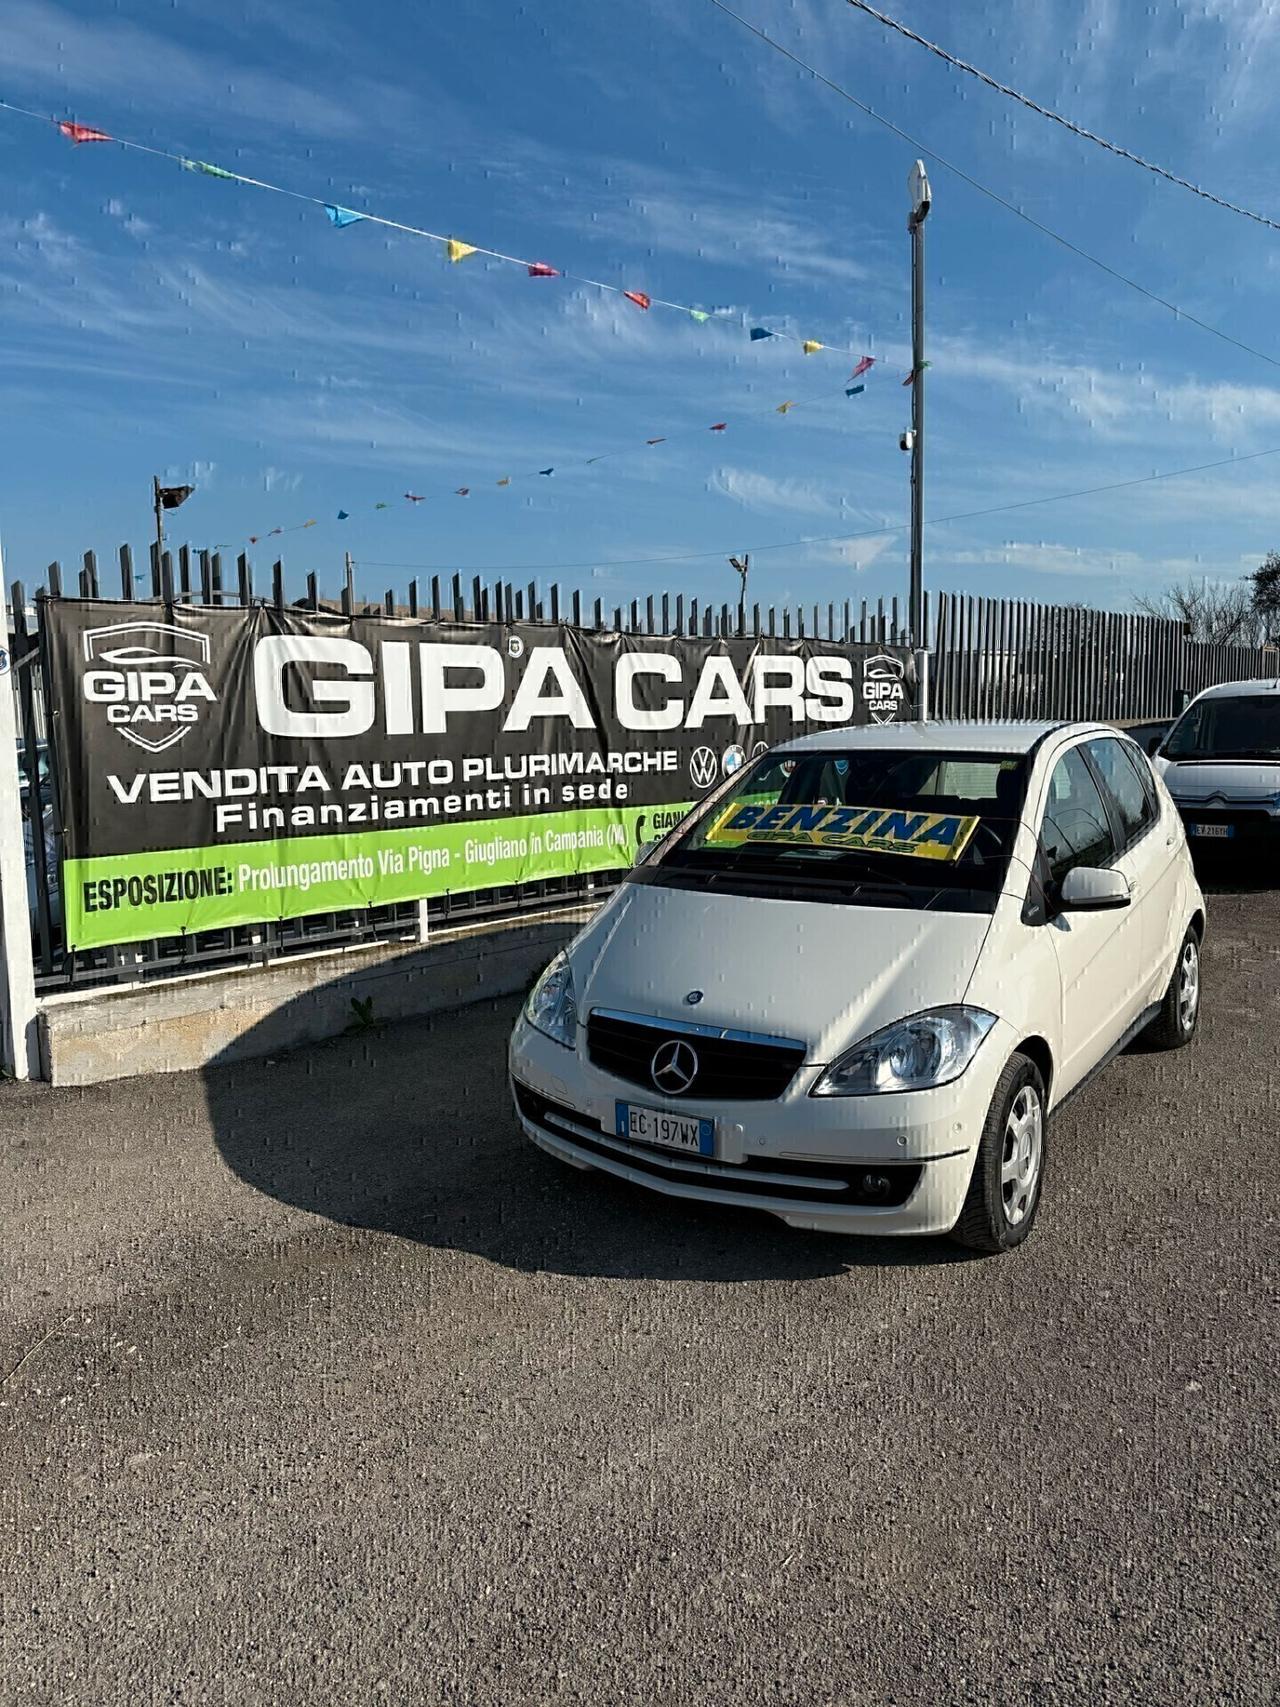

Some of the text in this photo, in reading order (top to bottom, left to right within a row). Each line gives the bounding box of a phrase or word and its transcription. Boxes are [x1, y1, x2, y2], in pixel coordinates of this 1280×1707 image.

[83, 671, 217, 702] GIPA
[253, 635, 854, 738] GIPA CARS
[863, 682, 904, 699] GIPA
[107, 704, 199, 723] CARS
[868, 700, 898, 711] CARS
[107, 751, 678, 804] VENDITA AUTO PLURIMARCHE
[216, 778, 629, 833] Finanziamenti in sede
[653, 810, 690, 829] GIAN
[724, 805, 963, 846] BENZINA
[747, 831, 917, 854] GIPA CARS
[83, 866, 234, 913] ESPOSIZIONE:
[238, 857, 374, 892] Prolungamento
[378, 850, 405, 875] Via
[408, 845, 450, 874] Pigna
[465, 835, 528, 866] Giugliano
[545, 825, 603, 853] Campania
[630, 1111, 647, 1135] EC
[653, 1117, 699, 1147] 197WX
